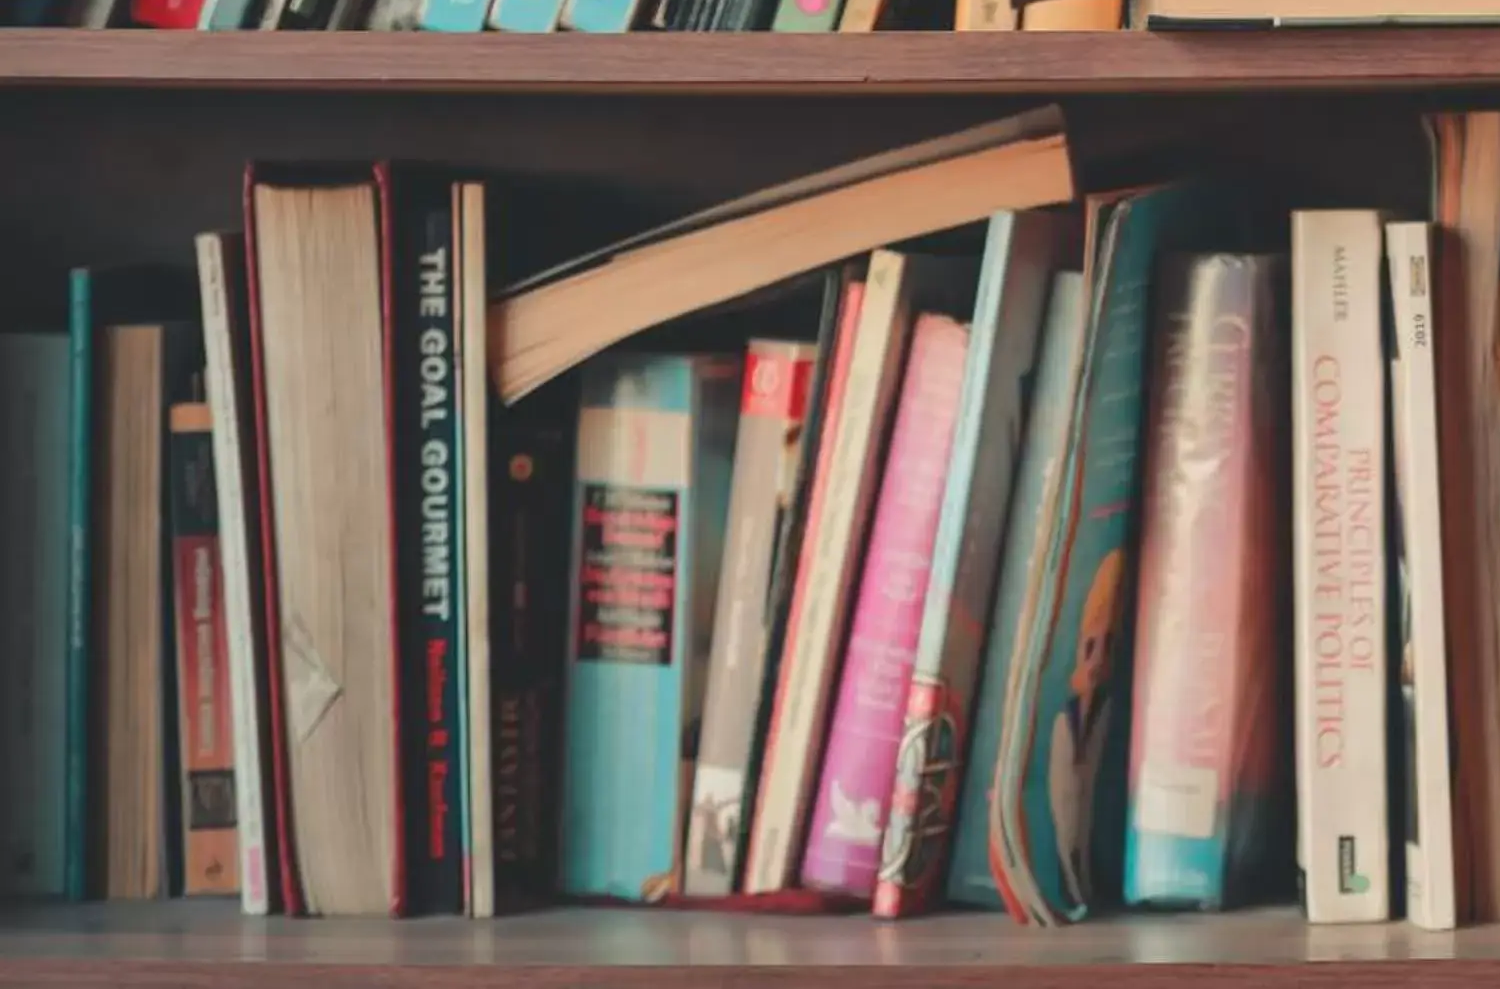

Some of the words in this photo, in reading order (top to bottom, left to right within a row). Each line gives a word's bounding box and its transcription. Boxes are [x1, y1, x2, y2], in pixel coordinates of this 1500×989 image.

[418, 247, 446, 318] THE
[1412, 314, 1427, 348] 2019
[419, 328, 447, 432] GOAL
[420, 440, 450, 621] GOURMET
[1311, 353, 1345, 603] COMPARATIVE
[1346, 447, 1376, 627] PRINCIPLES
[1313, 611, 1346, 771] POLITICS
[1347, 636, 1374, 677] OF
